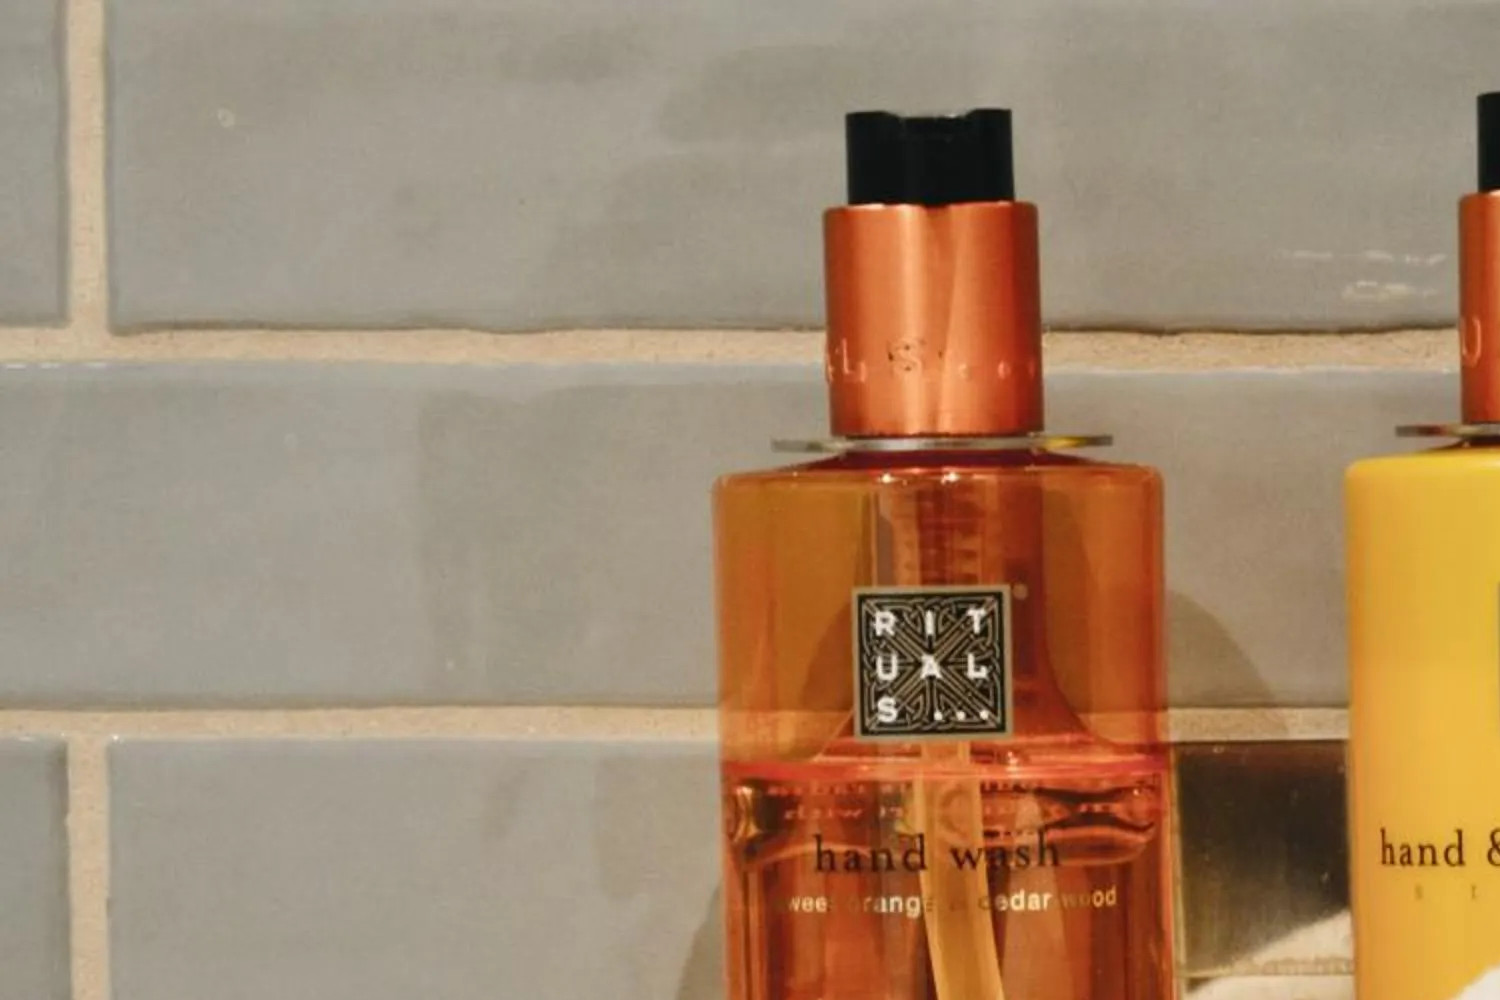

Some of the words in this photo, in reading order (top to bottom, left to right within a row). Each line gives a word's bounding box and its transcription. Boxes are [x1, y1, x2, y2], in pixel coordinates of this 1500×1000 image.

[812, 832, 927, 873] hand
[950, 829, 1061, 872] wash
[1379, 828, 1466, 867] hand
